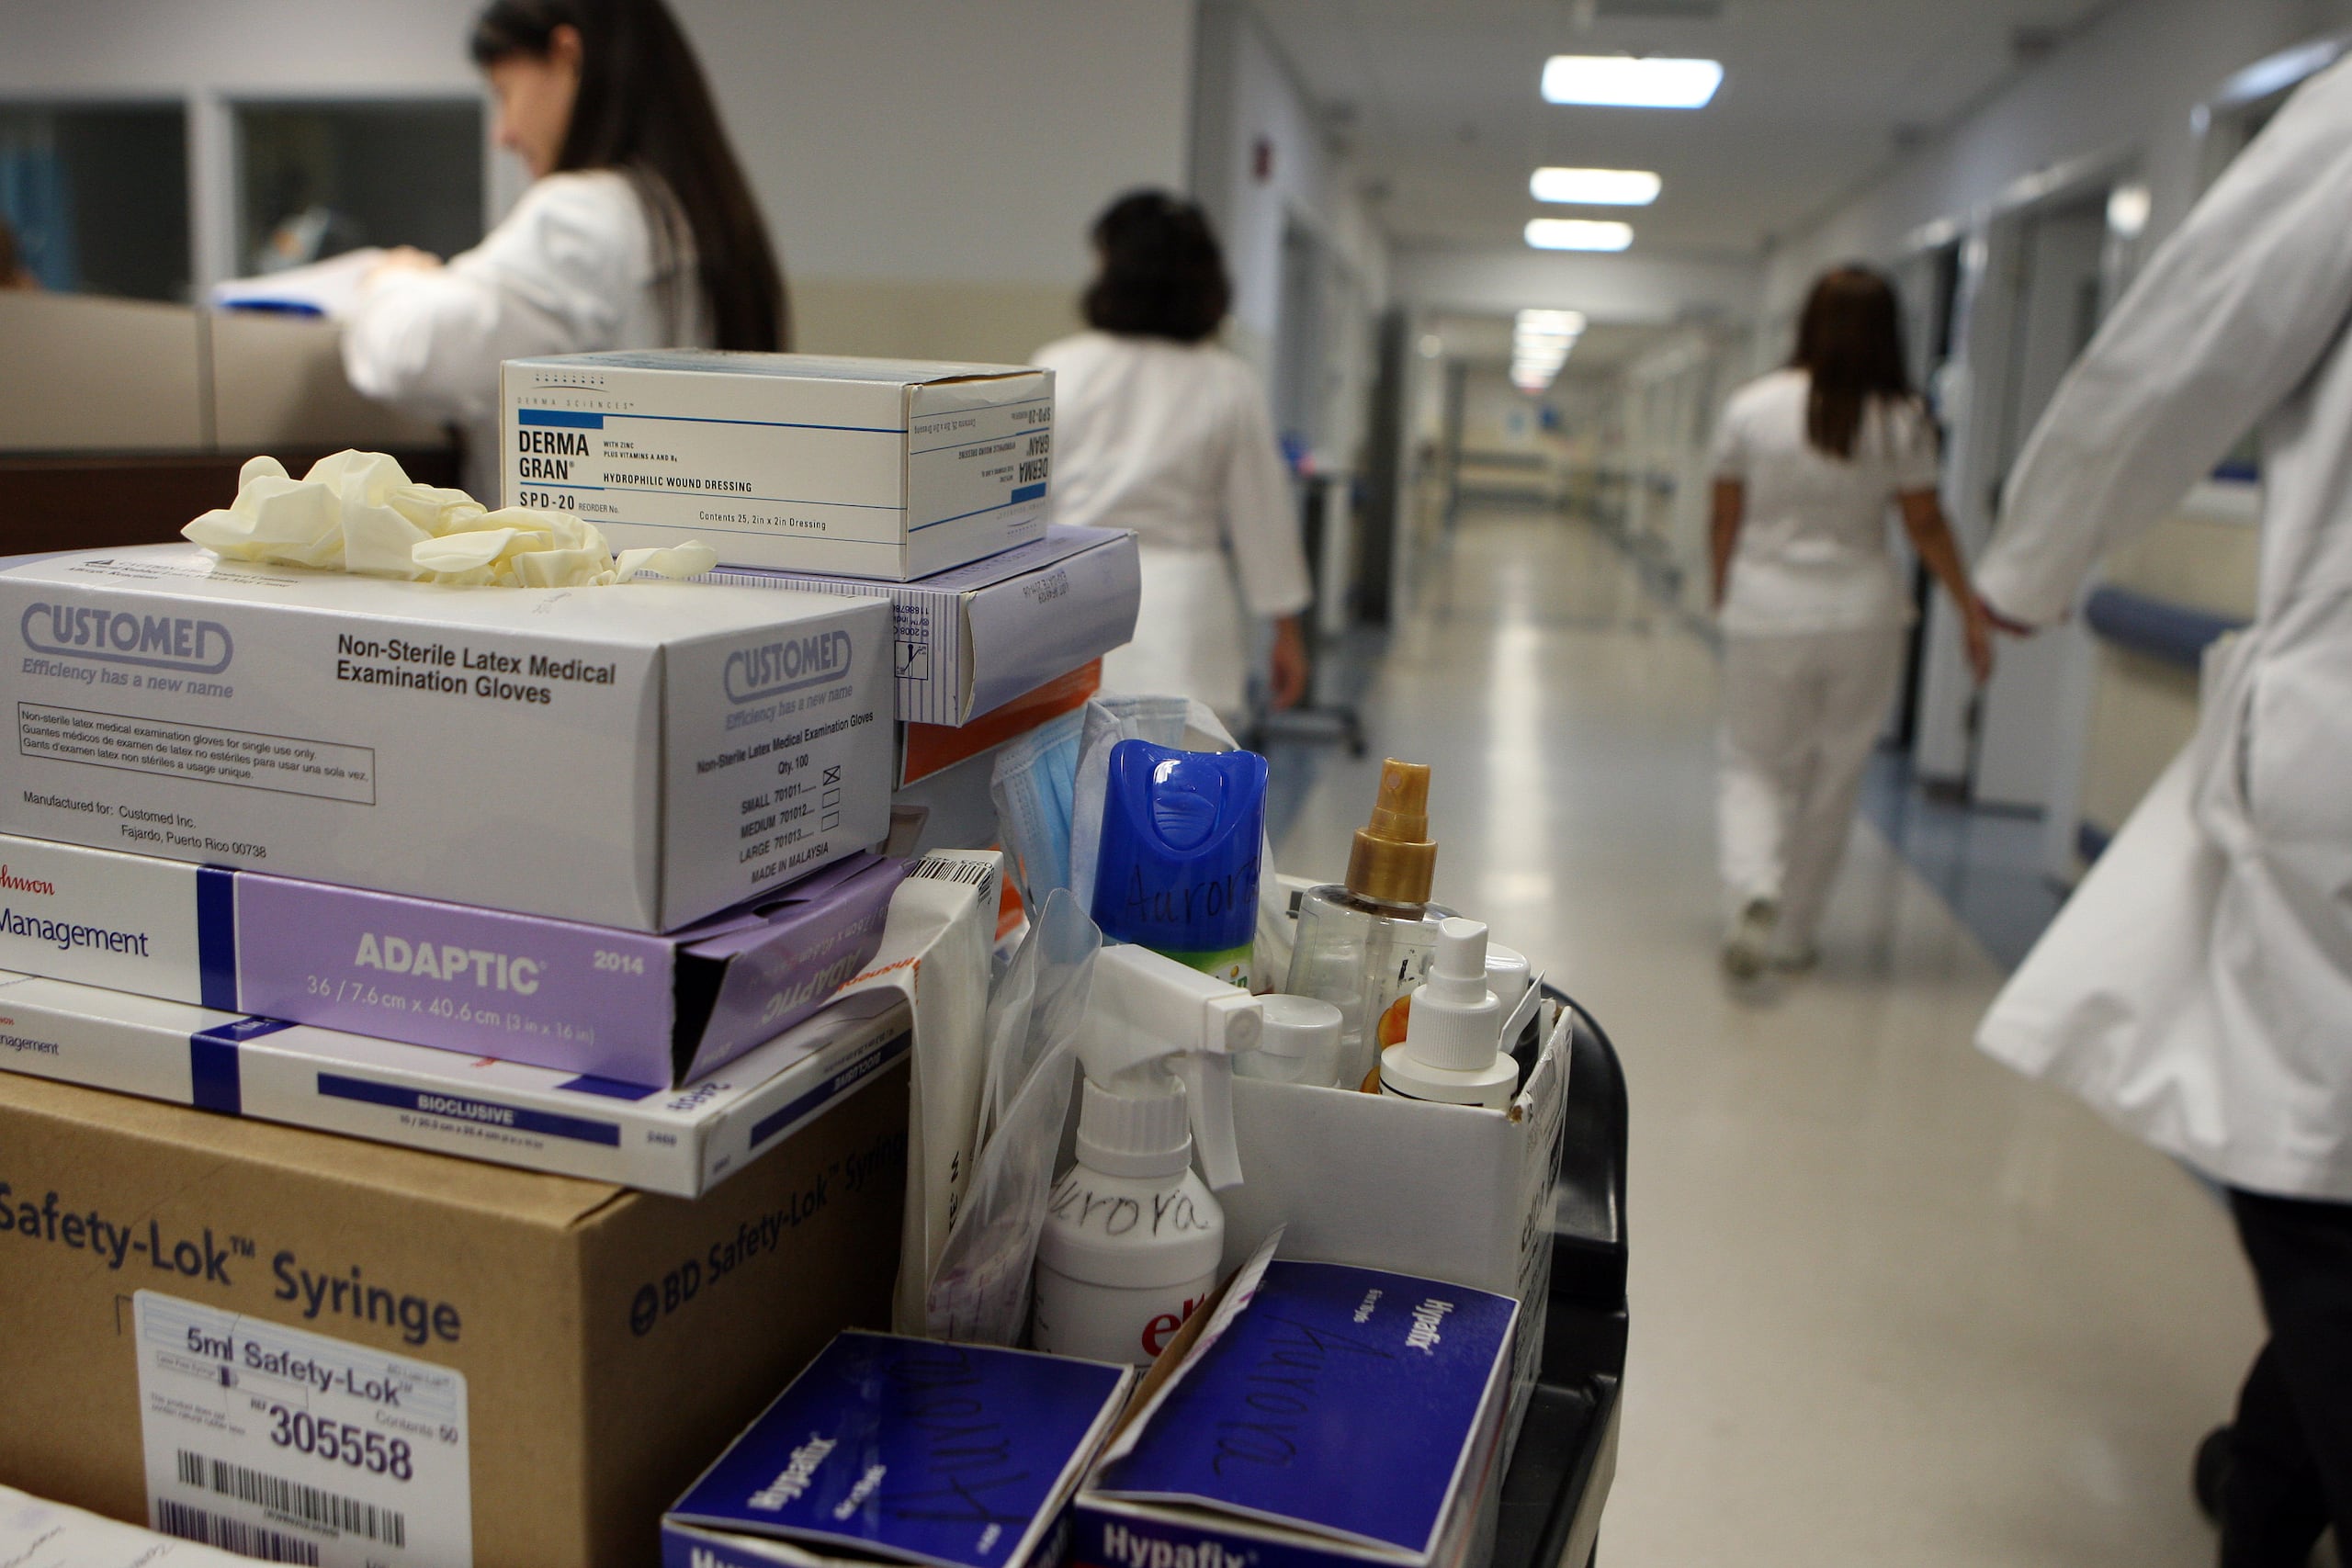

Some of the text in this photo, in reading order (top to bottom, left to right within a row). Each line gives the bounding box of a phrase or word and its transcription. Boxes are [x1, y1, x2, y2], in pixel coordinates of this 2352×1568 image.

[519, 430, 590, 457] DERMA
[620, 452, 649, 460] VITAMINS
[604, 473, 752, 492] HYDROPHILIC WOUND DRESSING
[1019, 457, 1048, 483] DERMA
[520, 491, 575, 510] SPD-20
[579, 502, 608, 513] REORDER
[699, 511, 736, 523] Contents
[738, 514, 750, 525] 25,
[752, 515, 765, 525] 2in
[775, 516, 786, 526] 2in
[789, 518, 826, 531] Dressing
[21, 602, 233, 674] CUSTOMED
[22, 658, 233, 699] Efficiency has a new name
[338, 634, 616, 685] Non-Sterile Latex Medical
[724, 630, 853, 705] CUSTOMED
[337, 660, 551, 705] Examination Gloves
[726, 683, 854, 731] Efficiency has a new name
[21, 710, 317, 761] Non-sterile latex medical examination gloves for single use only.
[22, 724, 61, 738] Guantes
[62, 730, 100, 744] médicos
[103, 736, 114, 745] de
[117, 739, 153, 751] examen
[155, 742, 167, 752] de
[170, 745, 192, 756] latex
[196, 750, 208, 759] no
[254, 758, 276, 769] para
[278, 761, 300, 772] usar
[303, 765, 321, 774] una
[323, 766, 345, 778] sola
[347, 771, 368, 783] vez.
[696, 711, 874, 774] Non-Sterile Latex Medical Examination Gloves
[23, 738, 50, 750] Gants
[51, 742, 96, 756] d'examen
[97, 749, 119, 760] latex
[121, 753, 139, 763] non
[141, 756, 175, 769] stériles
[187, 762, 216, 776] usage
[218, 767, 254, 780] unique.
[777, 753, 809, 776] Qty. 100
[23, 791, 197, 829] Manufactured for: Customed Inc.
[741, 797, 770, 815] SMALL
[741, 814, 776, 840] MEDIUM
[121, 825, 267, 859] Fajardo, Puerto Rico 00738
[740, 841, 770, 863] LARGE
[751, 841, 830, 884] MADE IN MALAYSIA
[0, 864, 55, 896] hnson
[355, 932, 645, 996] ADAPTIC 2014
[762, 948, 863, 1023] ADAPTIC
[307, 976, 330, 997] 36
[336, 980, 346, 1002] /
[352, 983, 379, 1006] 7.6
[382, 995, 405, 1010] cm
[413, 999, 421, 1013] x
[429, 998, 471, 1021] 40.6
[476, 1010, 501, 1026] cm
[526, 1016, 537, 1032] in
[542, 1023, 550, 1035] x
[557, 1022, 573, 1039] 16
[417, 1094, 516, 1125] BIOCLUSIVE
[663, 1258, 701, 1316] BD
[845, 1130, 909, 1190] Syring
[273, 1251, 462, 1347] Syringe
[187, 1326, 233, 1362] 5ml
[1405, 1297, 1453, 1356] Hypafix
[269, 1404, 413, 1482] 305558
